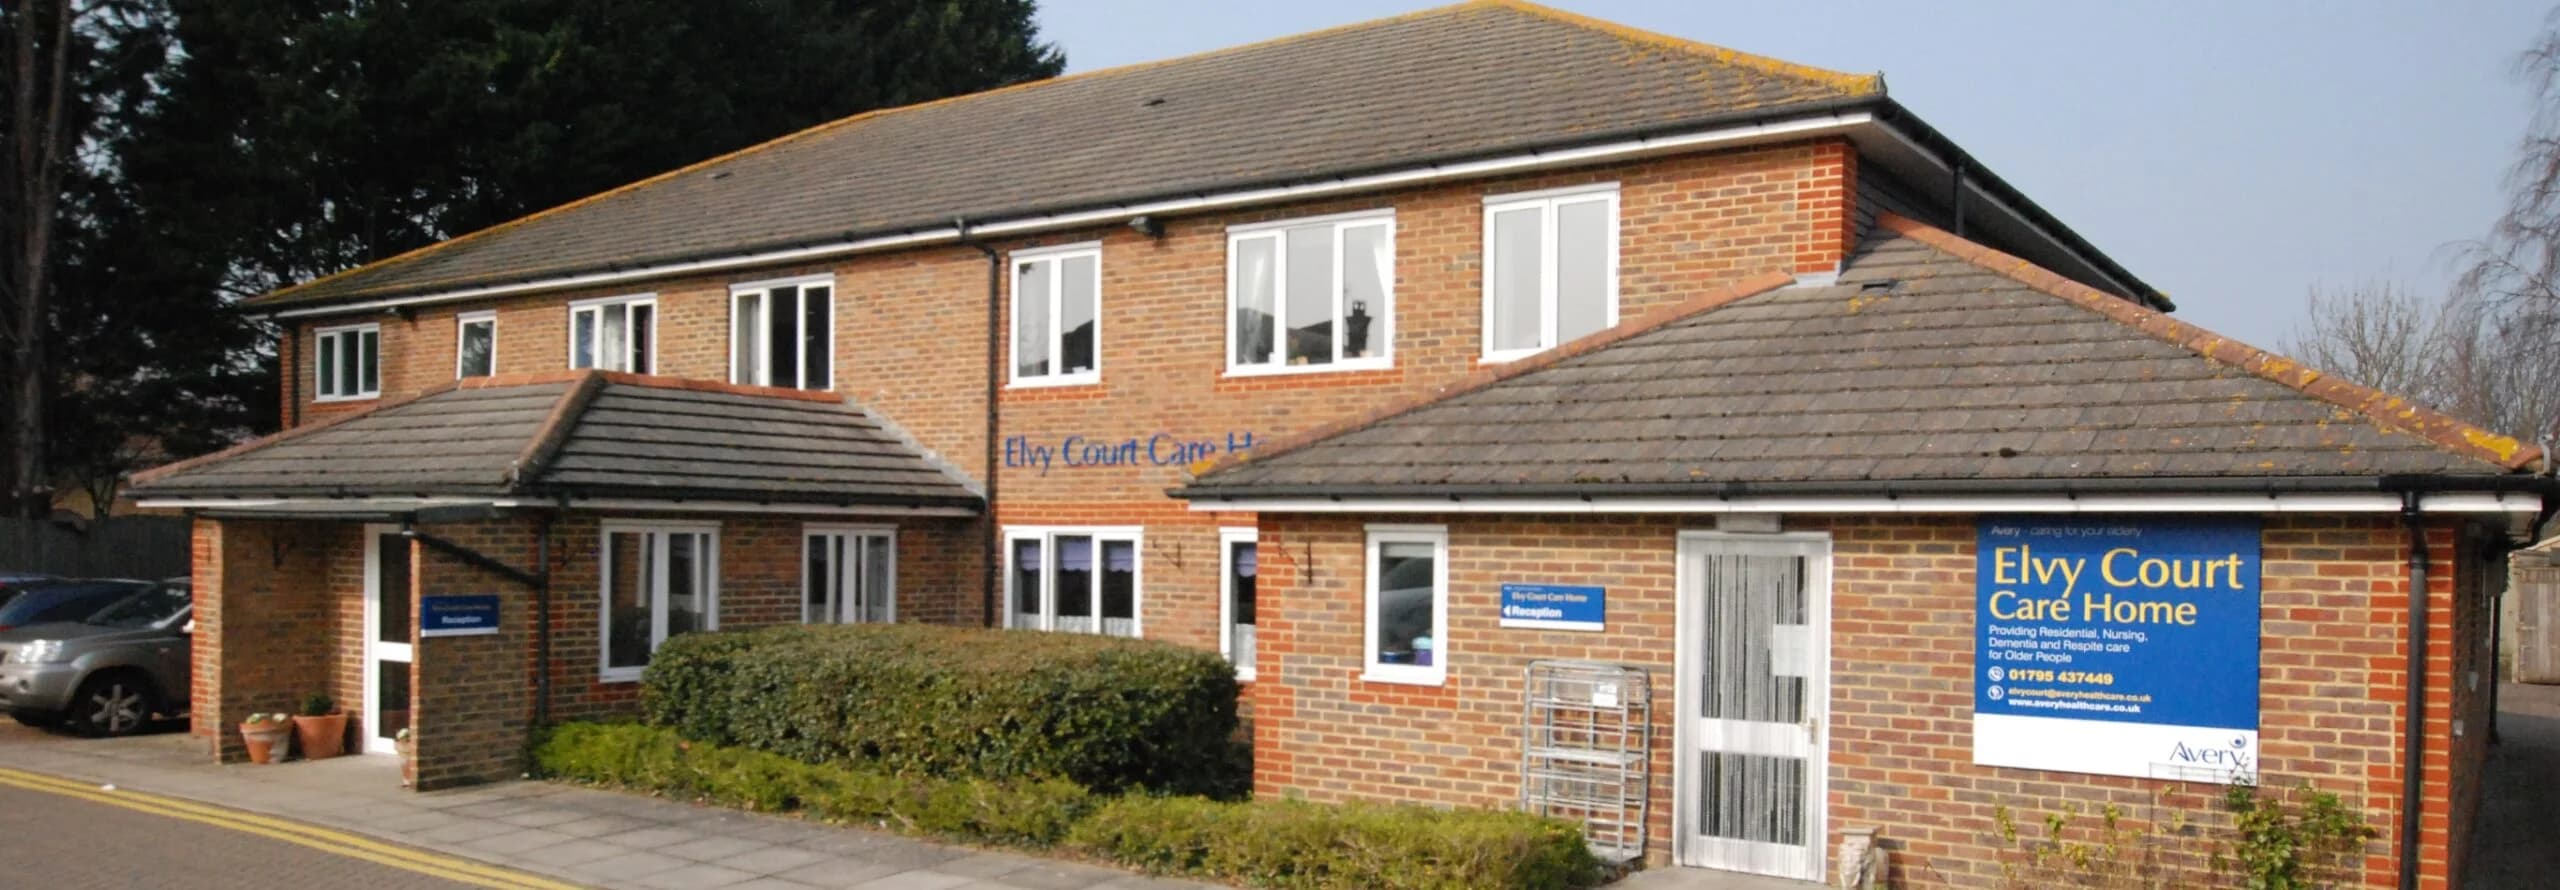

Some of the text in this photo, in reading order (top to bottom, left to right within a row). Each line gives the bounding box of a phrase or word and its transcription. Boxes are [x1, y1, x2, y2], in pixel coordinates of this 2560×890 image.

[1005, 435, 1055, 478] Elvy
[1062, 435, 1137, 467] Court
[1991, 525, 2021, 537] Avery
[2065, 526, 2079, 536] for
[2080, 527, 2105, 537] your
[1994, 544, 2244, 599] Elvy Court
[1512, 606, 1562, 618] Reception
[1989, 590, 2197, 625] Care Home
[1988, 625, 2037, 638] Providing
[2039, 627, 2100, 640] Residential,
[1988, 637, 2130, 653] Dementia and Respite care
[1988, 650, 2073, 664] for Older People
[2008, 668, 2114, 685] 01795 437449
[2008, 699, 2141, 713] www.averyhealthcare.co.uk
[2169, 741, 2246, 773] Avery
